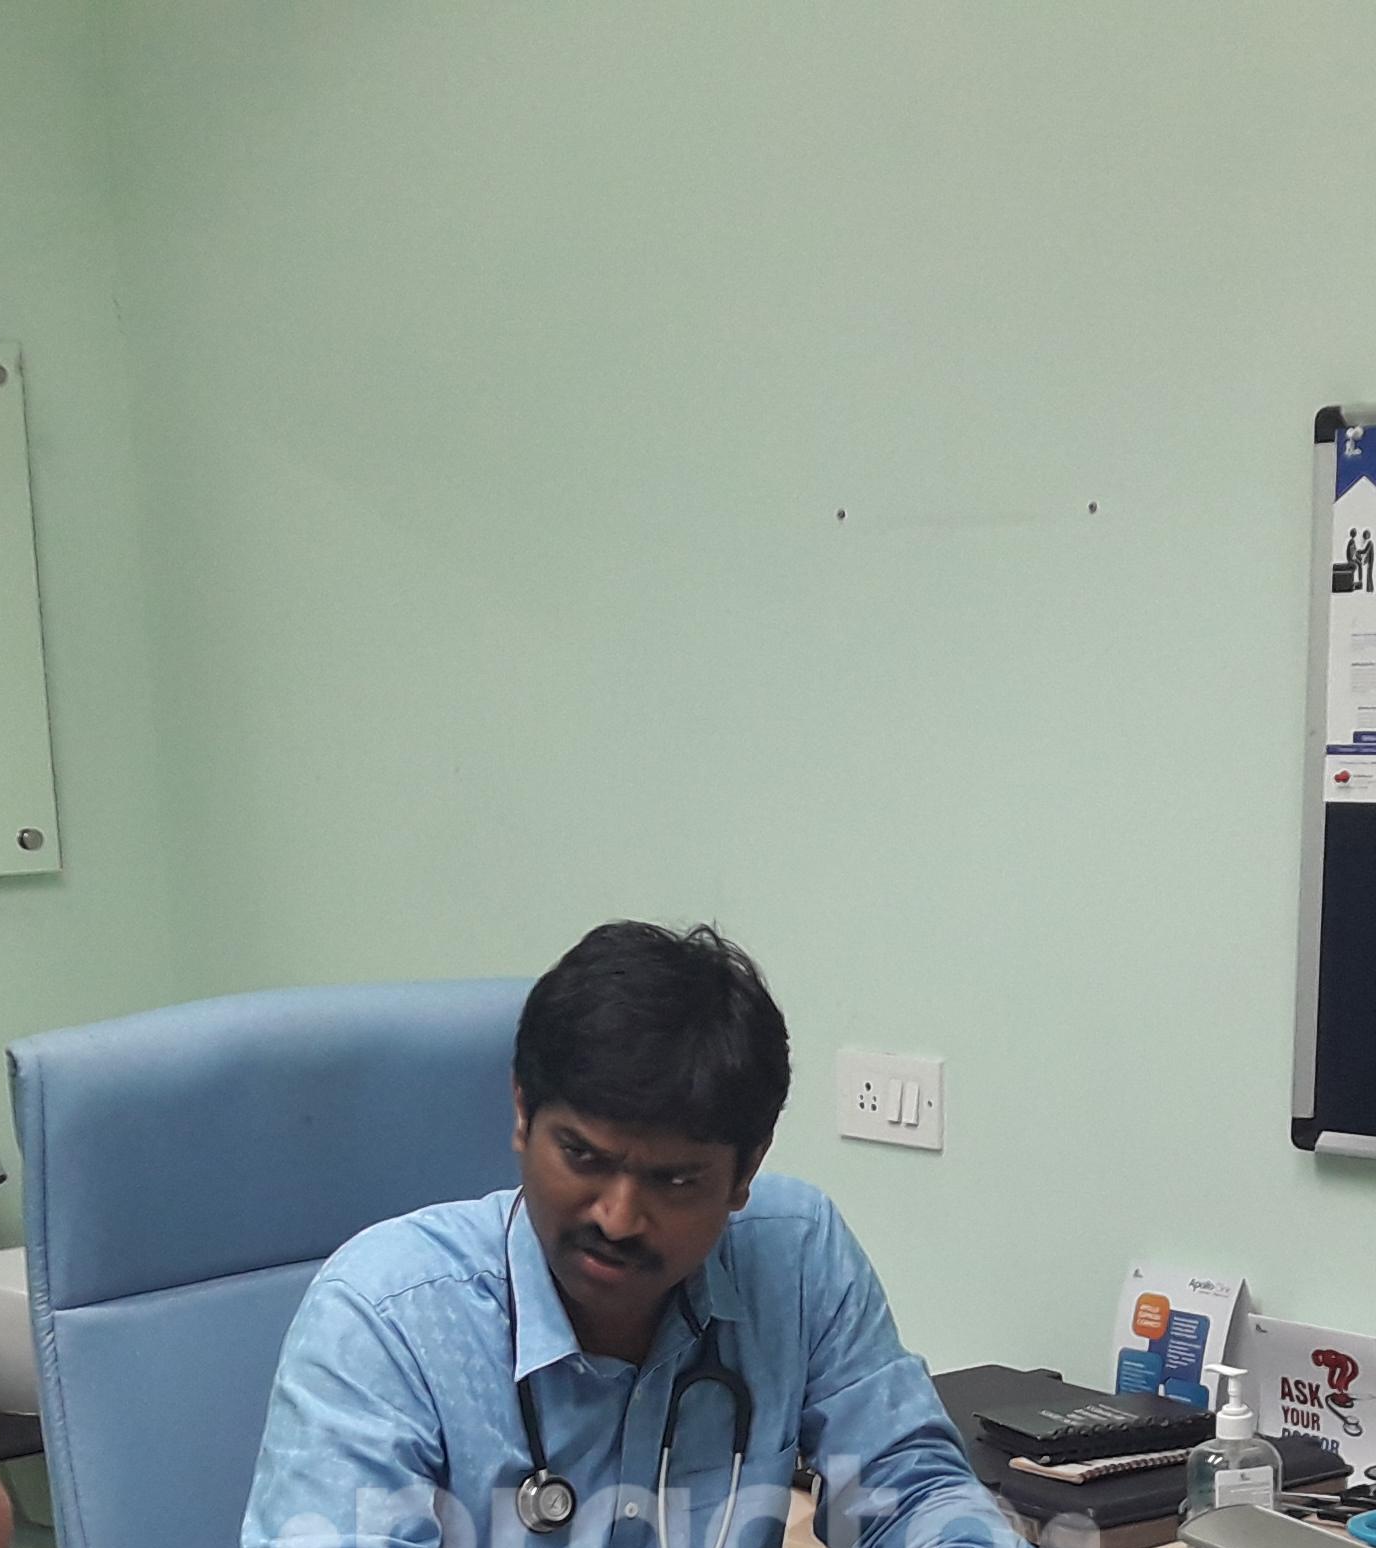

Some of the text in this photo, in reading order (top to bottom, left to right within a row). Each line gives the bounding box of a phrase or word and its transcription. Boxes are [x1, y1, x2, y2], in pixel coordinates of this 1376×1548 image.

[1280, 1376, 1324, 1410] ASK
[1281, 1405, 1321, 1432] YOUR
[1282, 1427, 1340, 1455] DOR
